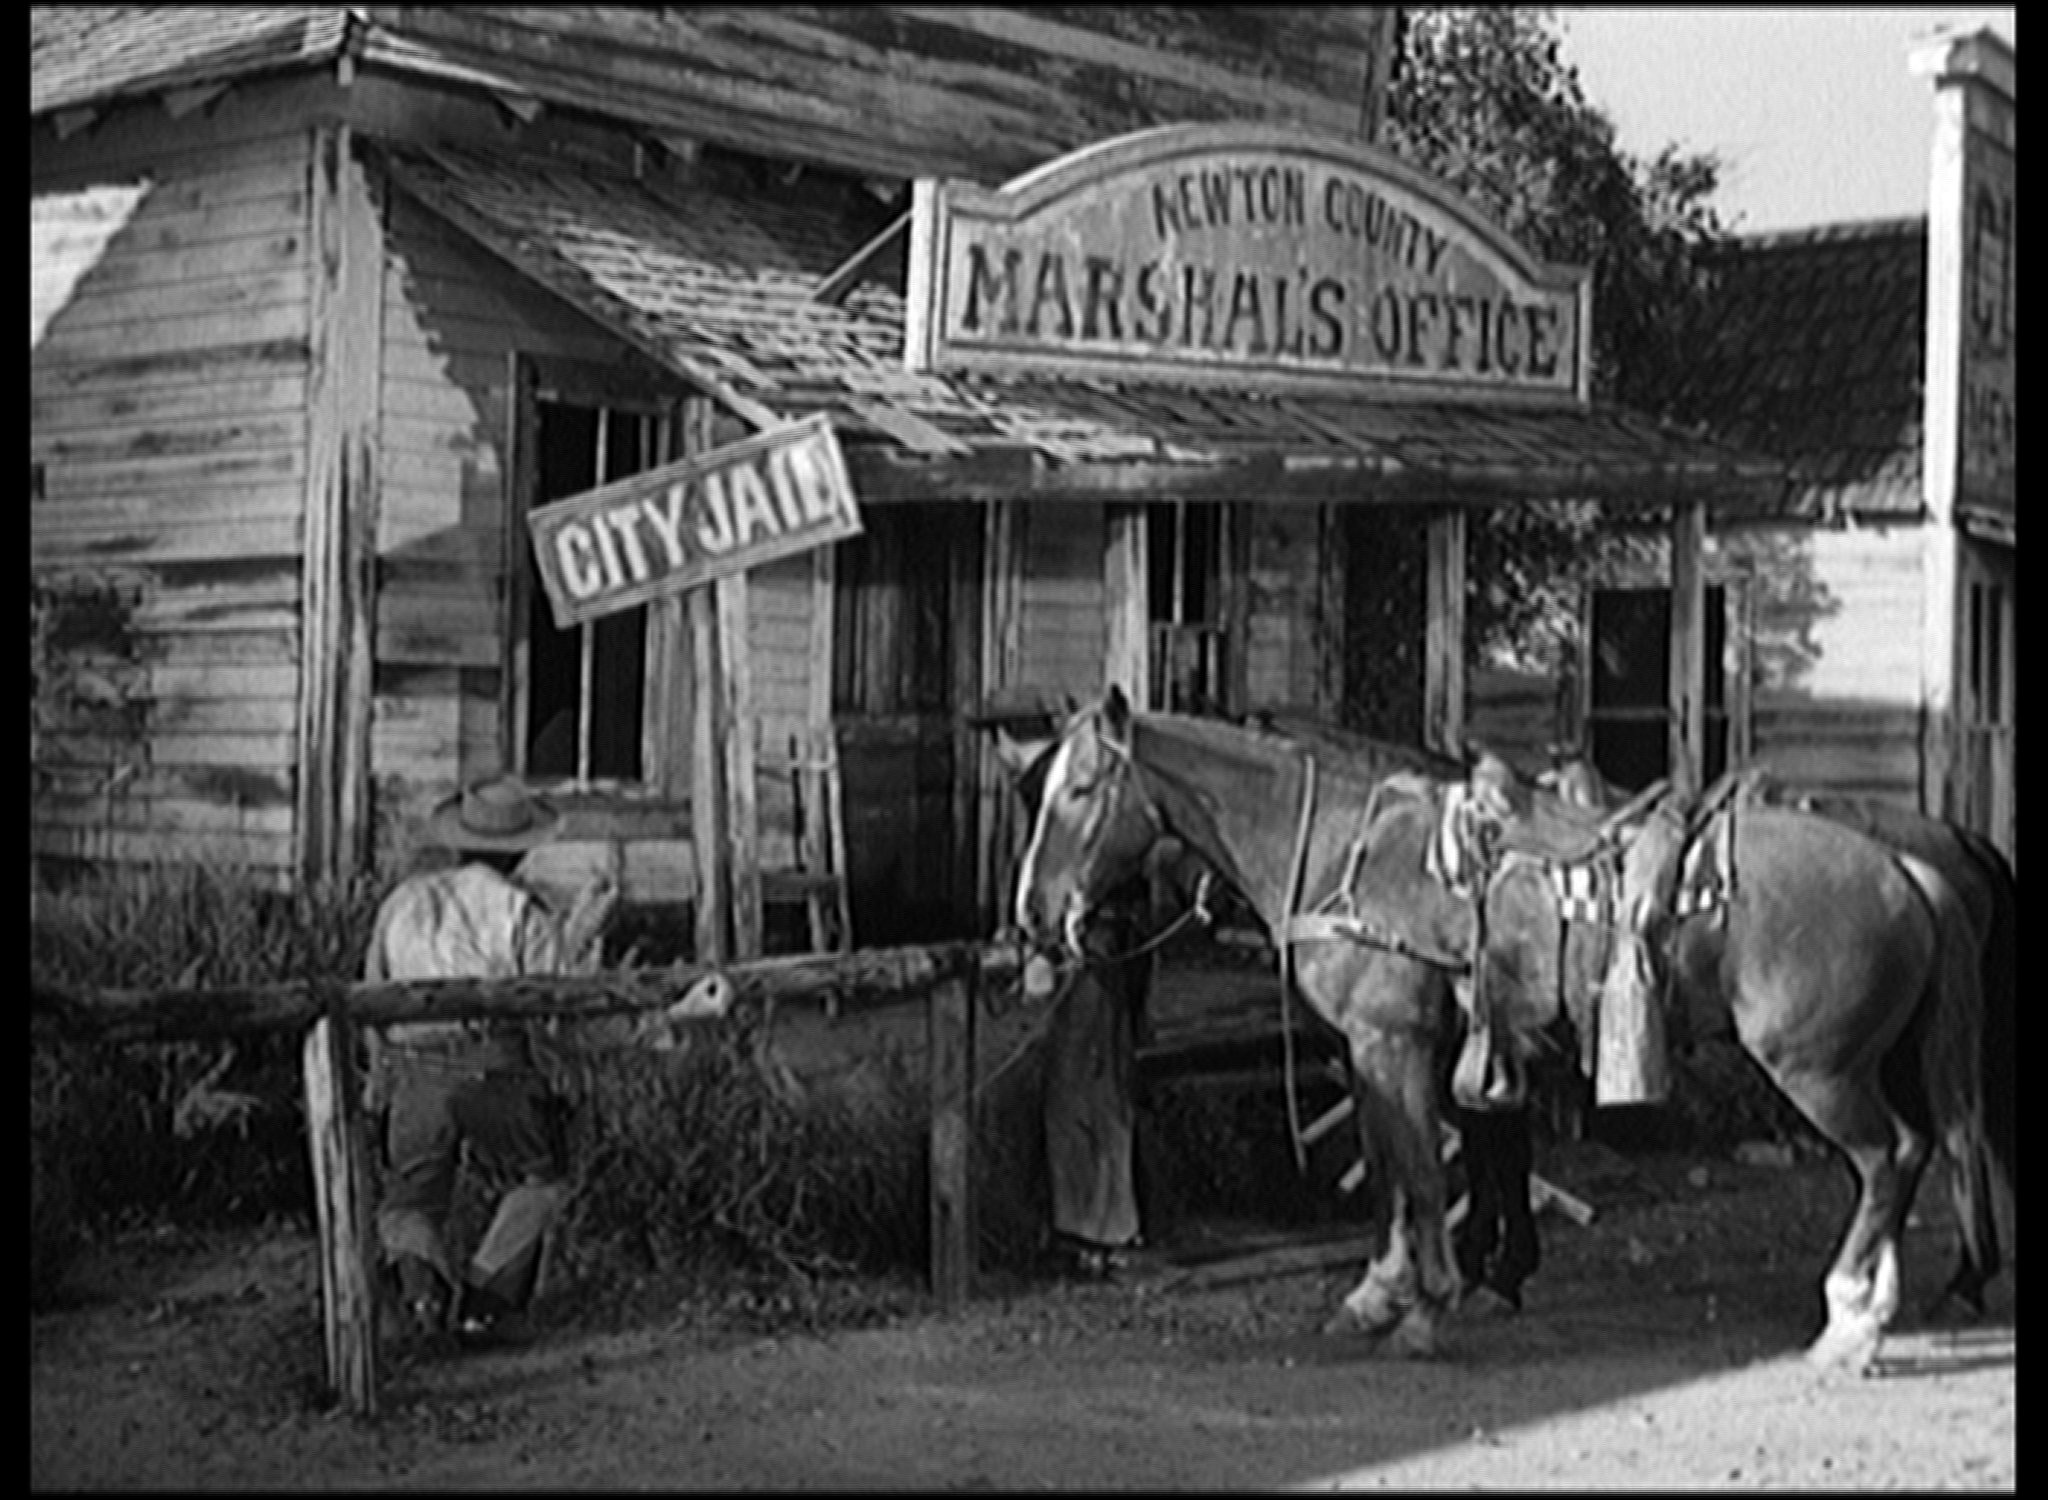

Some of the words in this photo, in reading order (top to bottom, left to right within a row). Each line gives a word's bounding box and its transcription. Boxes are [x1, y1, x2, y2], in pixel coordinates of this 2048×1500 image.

[1152, 163, 1305, 241] NEWTON
[1324, 175, 1449, 276] COUNTY
[961, 244, 1346, 357] MARSHAL'S
[1371, 283, 1558, 379] OFFICE
[556, 480, 688, 599] CITY
[697, 440, 837, 554] JAIL
